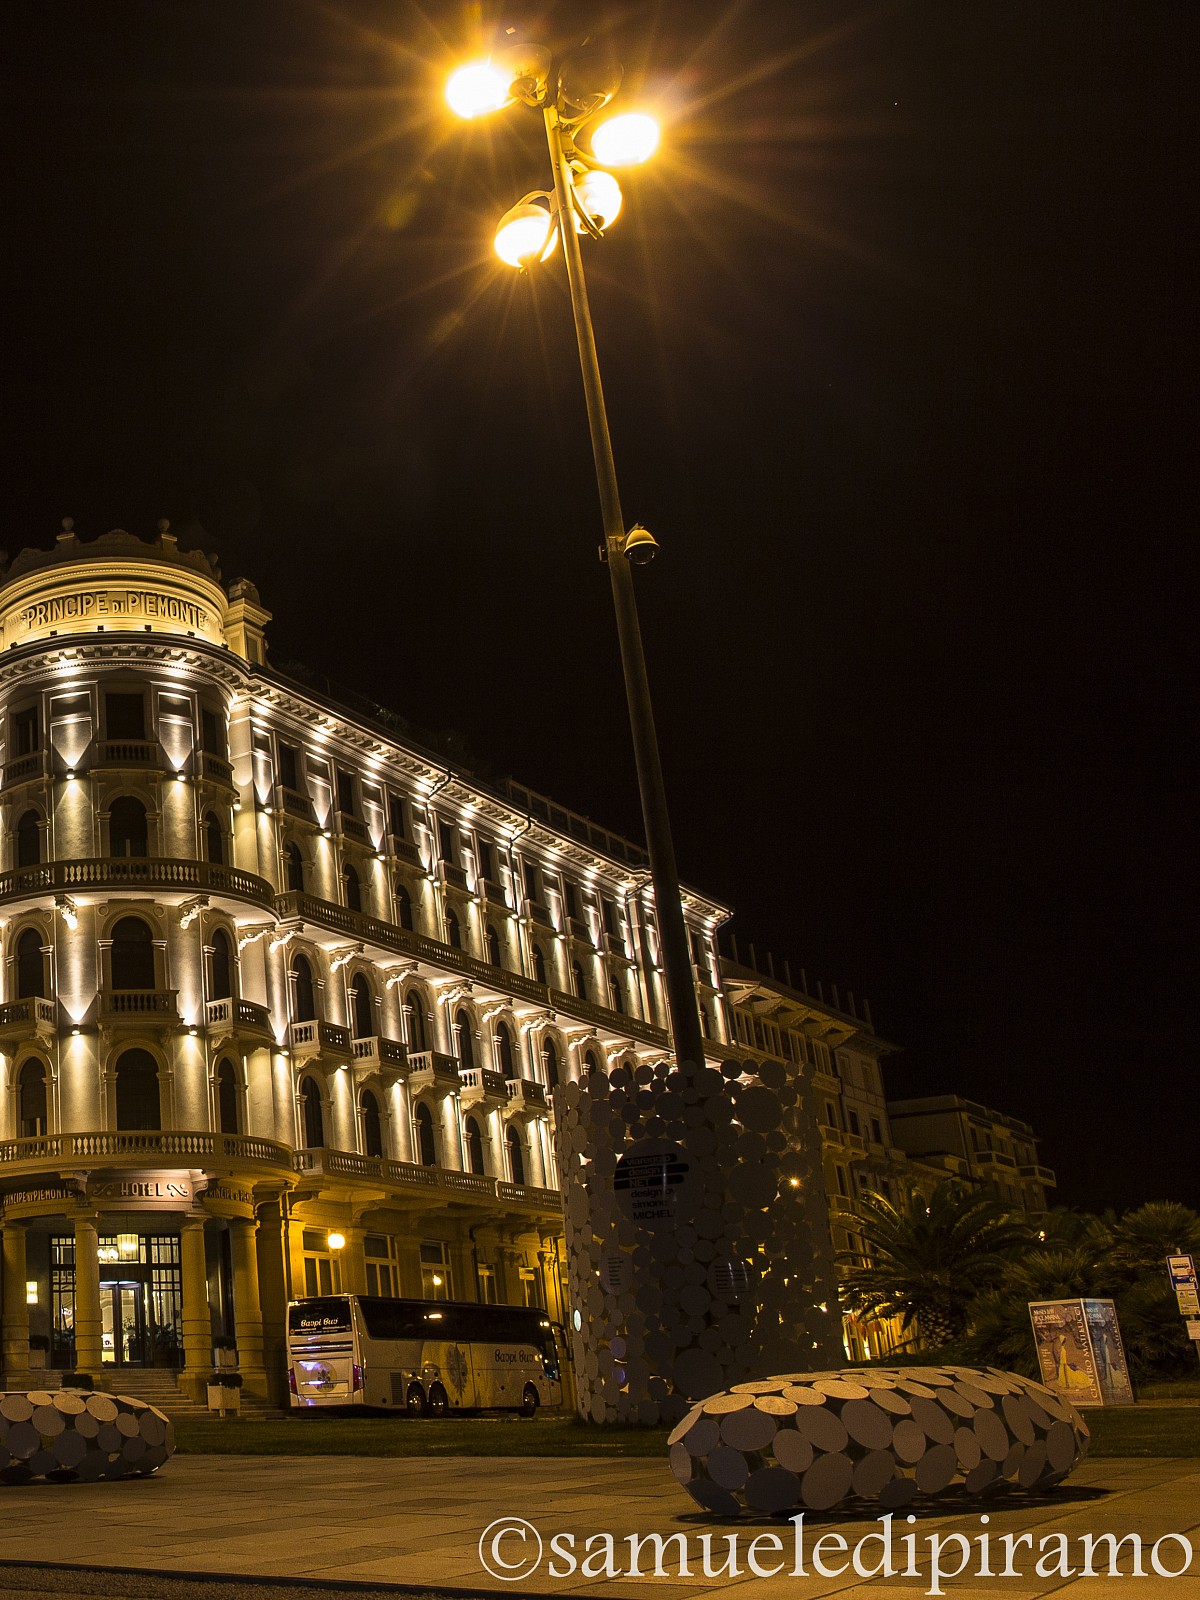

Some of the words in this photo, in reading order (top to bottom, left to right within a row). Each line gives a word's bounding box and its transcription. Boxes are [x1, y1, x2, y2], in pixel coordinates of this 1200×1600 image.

[25, 592, 108, 629] PRINCIPE
[128, 590, 206, 631] PIEMONTE
[120, 1182, 165, 1197] HOTEL
[629, 1178, 649, 1188] NET
